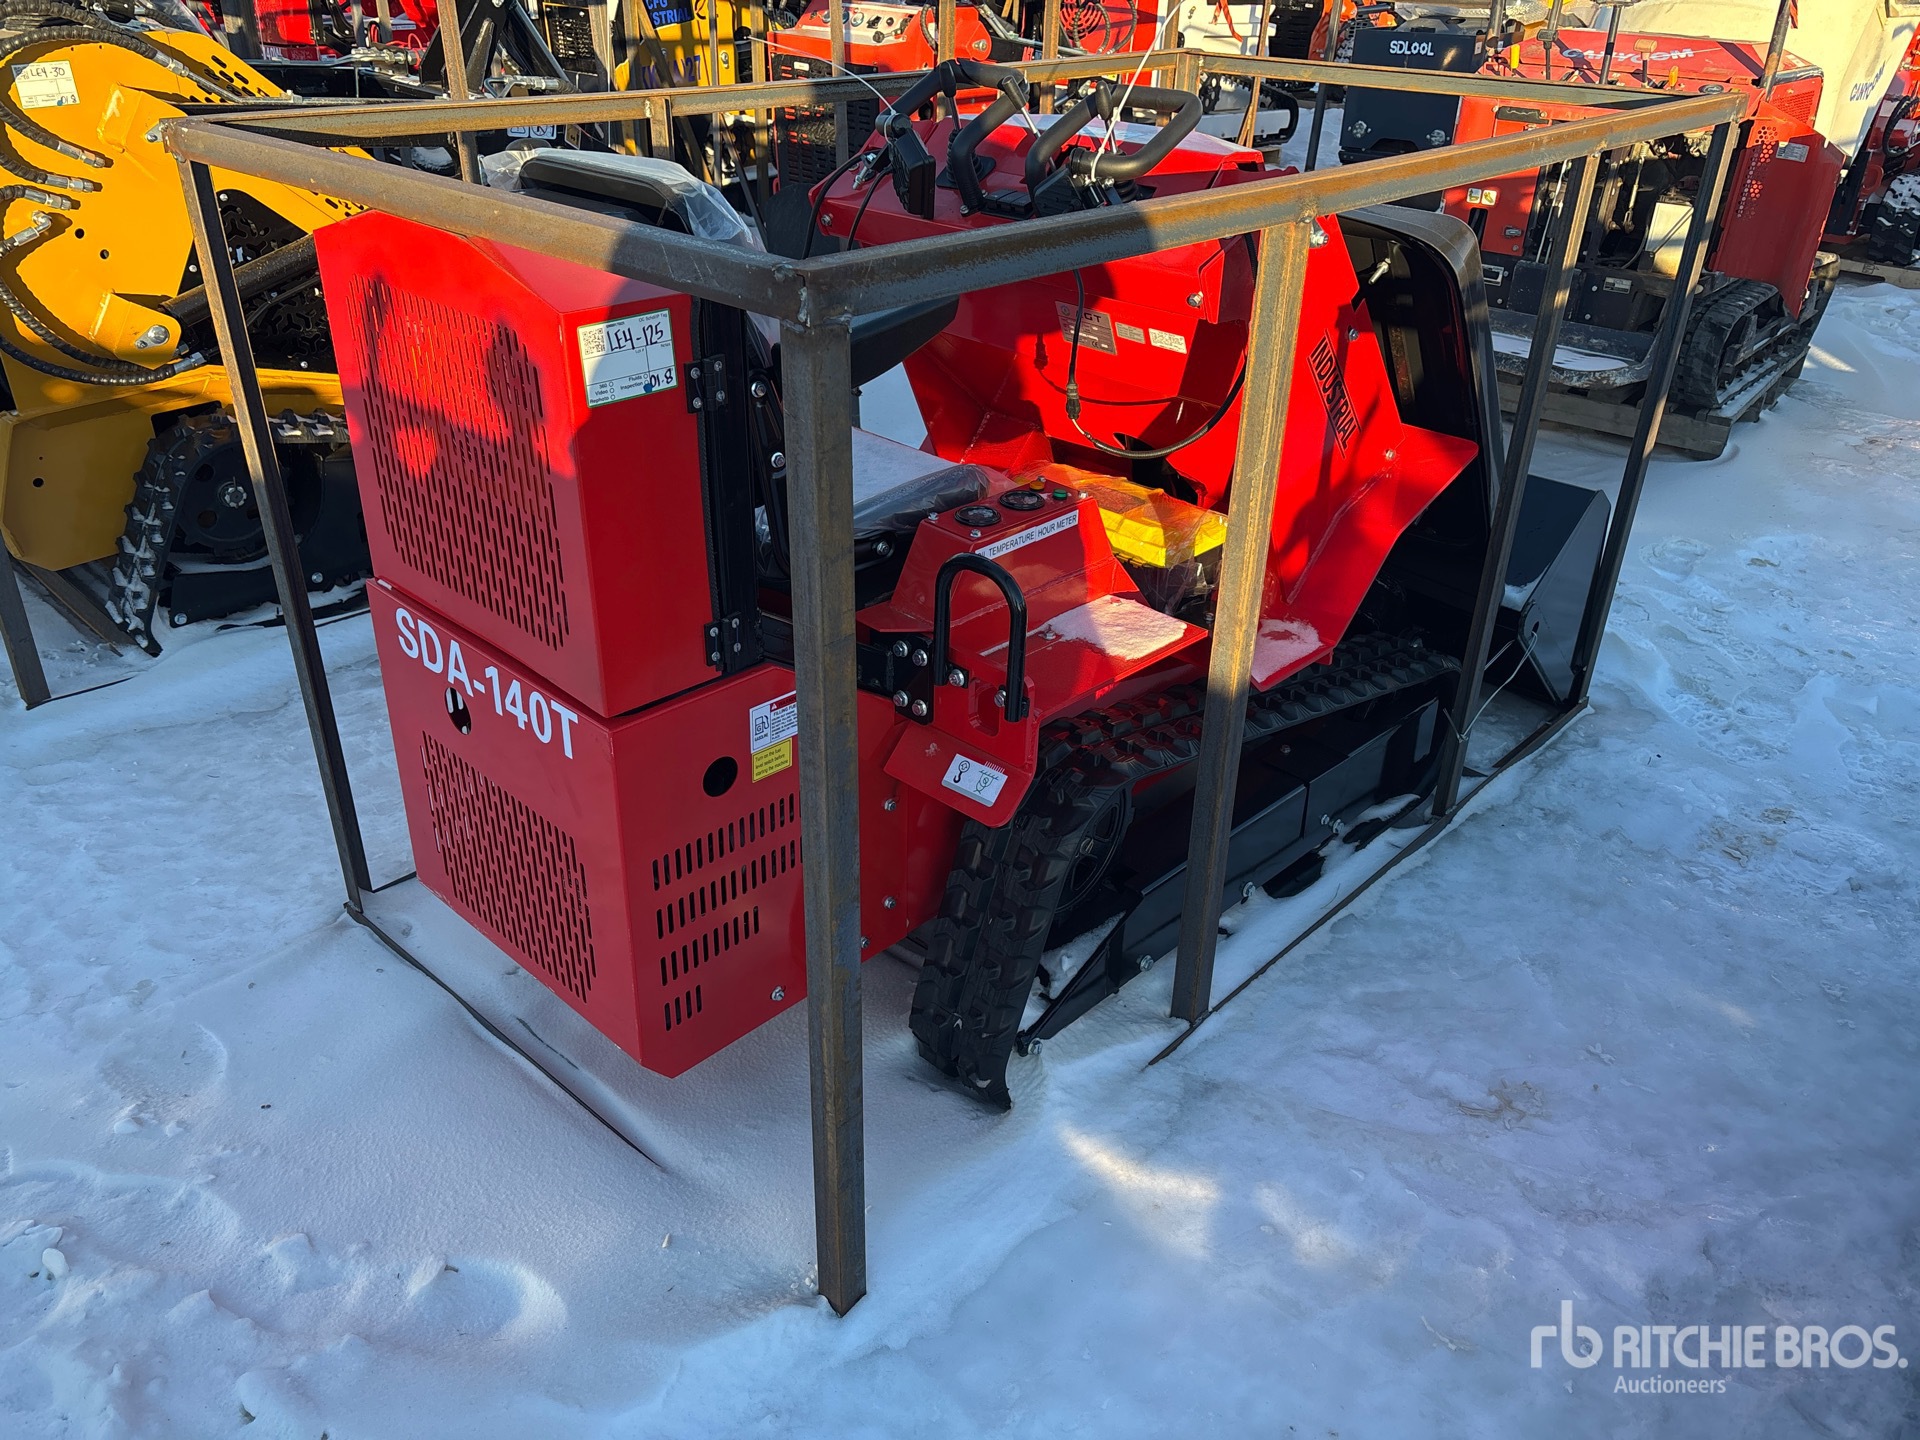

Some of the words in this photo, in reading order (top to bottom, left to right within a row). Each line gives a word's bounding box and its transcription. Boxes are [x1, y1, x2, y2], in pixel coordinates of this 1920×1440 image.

[651, 7, 691, 25] STRIAL
[607, 321, 664, 352] LE4-125
[620, 381, 643, 390] Inspection
[1311, 335, 1357, 449] INDUSTRIAL
[1037, 522, 1056, 538] HOUR
[1056, 514, 1077, 530] METER
[988, 531, 1035, 557] TEMPERATURE
[395, 607, 579, 760] SDA-140T
